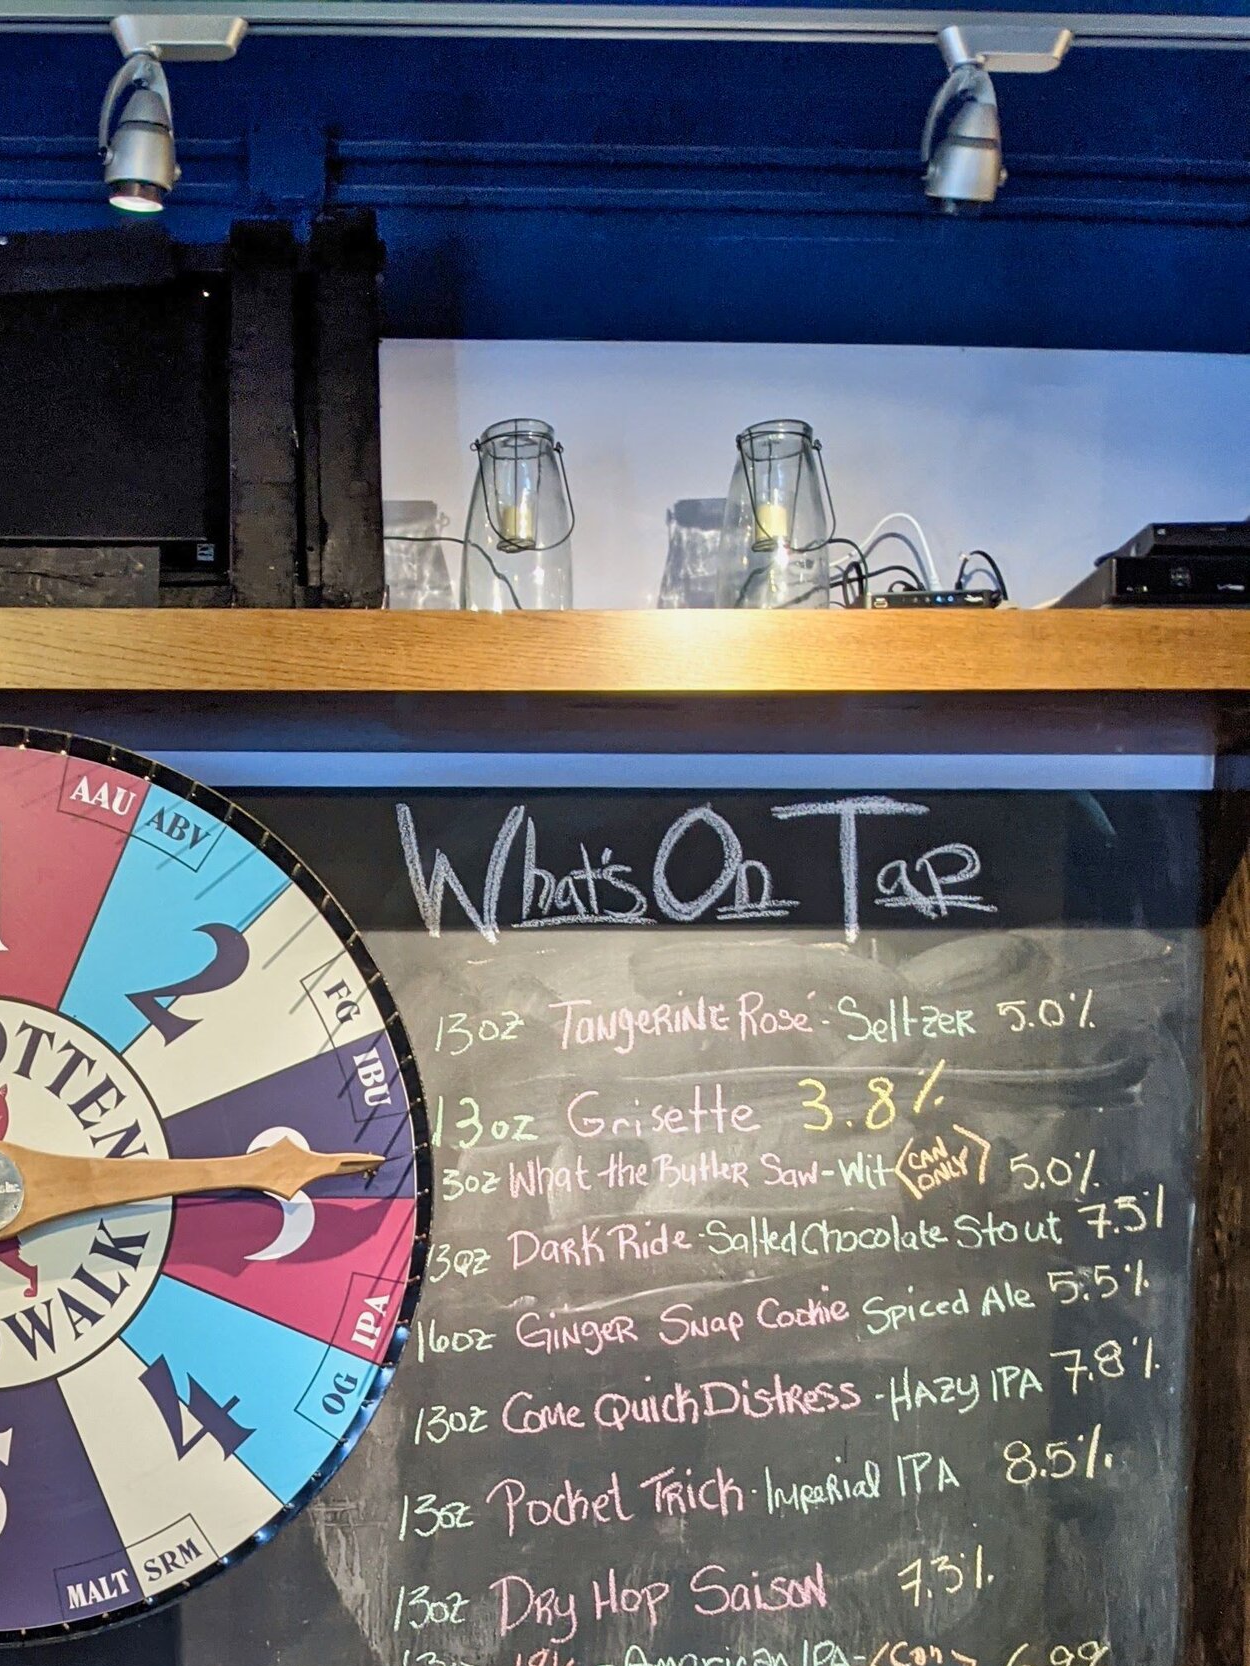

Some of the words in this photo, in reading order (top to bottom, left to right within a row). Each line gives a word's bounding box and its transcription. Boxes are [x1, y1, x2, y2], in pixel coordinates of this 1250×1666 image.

[70, 775, 136, 816] AAU
[145, 806, 212, 850] ABV
[653, 802, 780, 921] On
[125, 922, 251, 1047] 2
[323, 978, 361, 1025] FG
[353, 1047, 391, 1106] IBU
[567, 1084, 761, 1137] Grisette
[243, 1126, 315, 1261] 3
[510, 1155, 592, 1198] What
[598, 1152, 650, 1188] the
[802, 1215, 949, 1256] Chocolate
[953, 1211, 1063, 1249] Stout
[351, 1294, 390, 1350] IPA
[862, 1286, 970, 1334] Spiced
[982, 1280, 1036, 1316] Ale
[321, 1372, 359, 1416] OG
[991, 1365, 1043, 1401] IPA
[138, 1353, 257, 1462] 4
[897, 1452, 960, 1497] IPA
[143, 1537, 203, 1582] SRM
[66, 1568, 131, 1610] MALT
